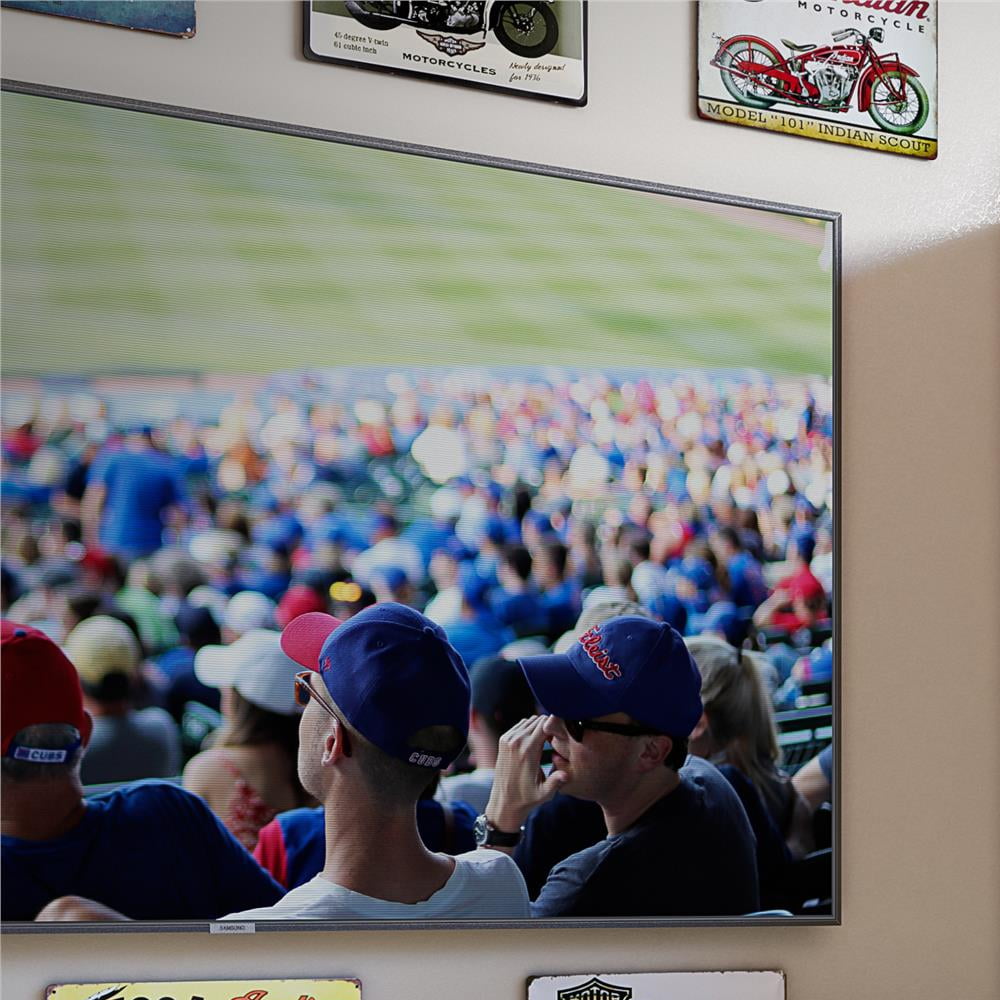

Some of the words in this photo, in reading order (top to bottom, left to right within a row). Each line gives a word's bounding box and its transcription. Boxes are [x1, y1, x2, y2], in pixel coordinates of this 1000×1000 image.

[797, 1, 925, 33] MOTORCYCLE
[343, 33, 366, 43] degree
[402, 52, 497, 75] MOTORCYCLES
[706, 102, 767, 124] MODEL
[818, 124, 875, 143] INDIAN
[879, 134, 932, 153] SCOUT
[31, 751, 63, 759] CUBS
